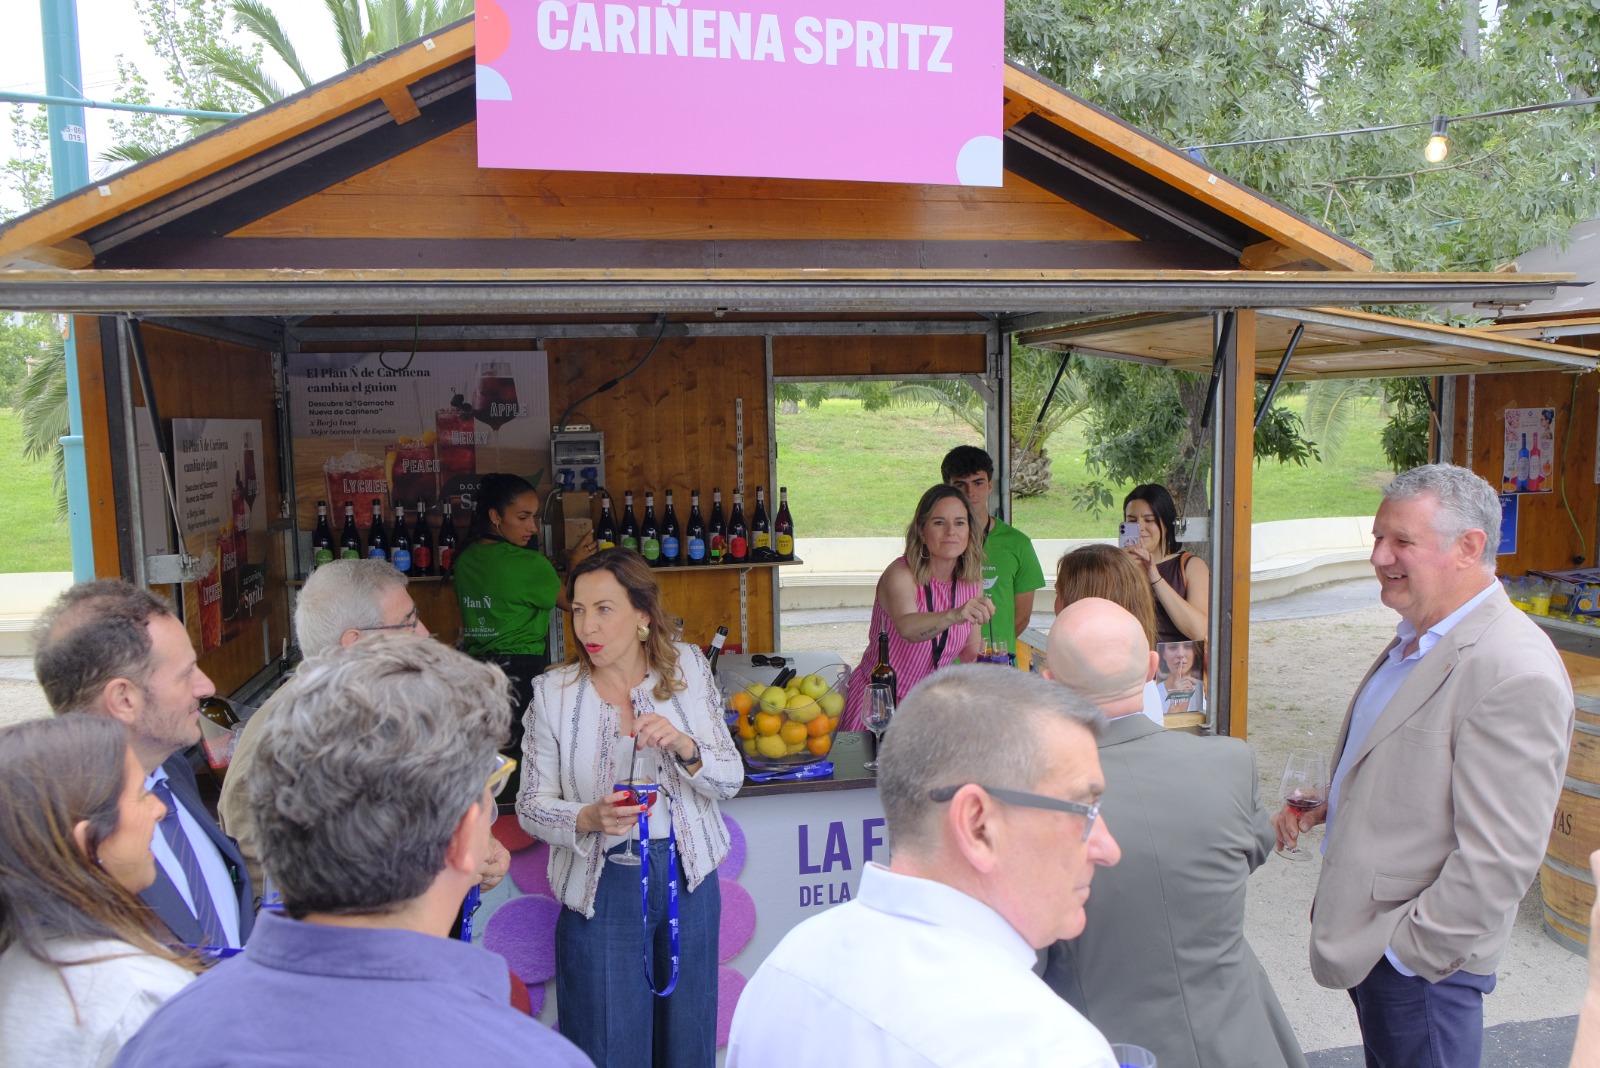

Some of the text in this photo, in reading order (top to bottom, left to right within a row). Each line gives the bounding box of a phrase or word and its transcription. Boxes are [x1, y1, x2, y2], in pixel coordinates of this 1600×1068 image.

[536, 0, 954, 73] CARIÑENA SPRITZ
[69, 133, 82, 142] 015
[306, 365, 431, 379] El Plan Ñ de Cariñena
[307, 382, 397, 395] cambia el guion
[308, 400, 344, 408] Descubre
[490, 401, 528, 418] APPLE
[316, 419, 338, 428] Borja
[451, 430, 489, 446] BERRY
[402, 458, 441, 474] PEACH
[343, 478, 388, 494] LYCHEE
[483, 595, 492, 609] Ñ
[798, 817, 886, 875] LA F
[799, 881, 852, 908] DE LA
